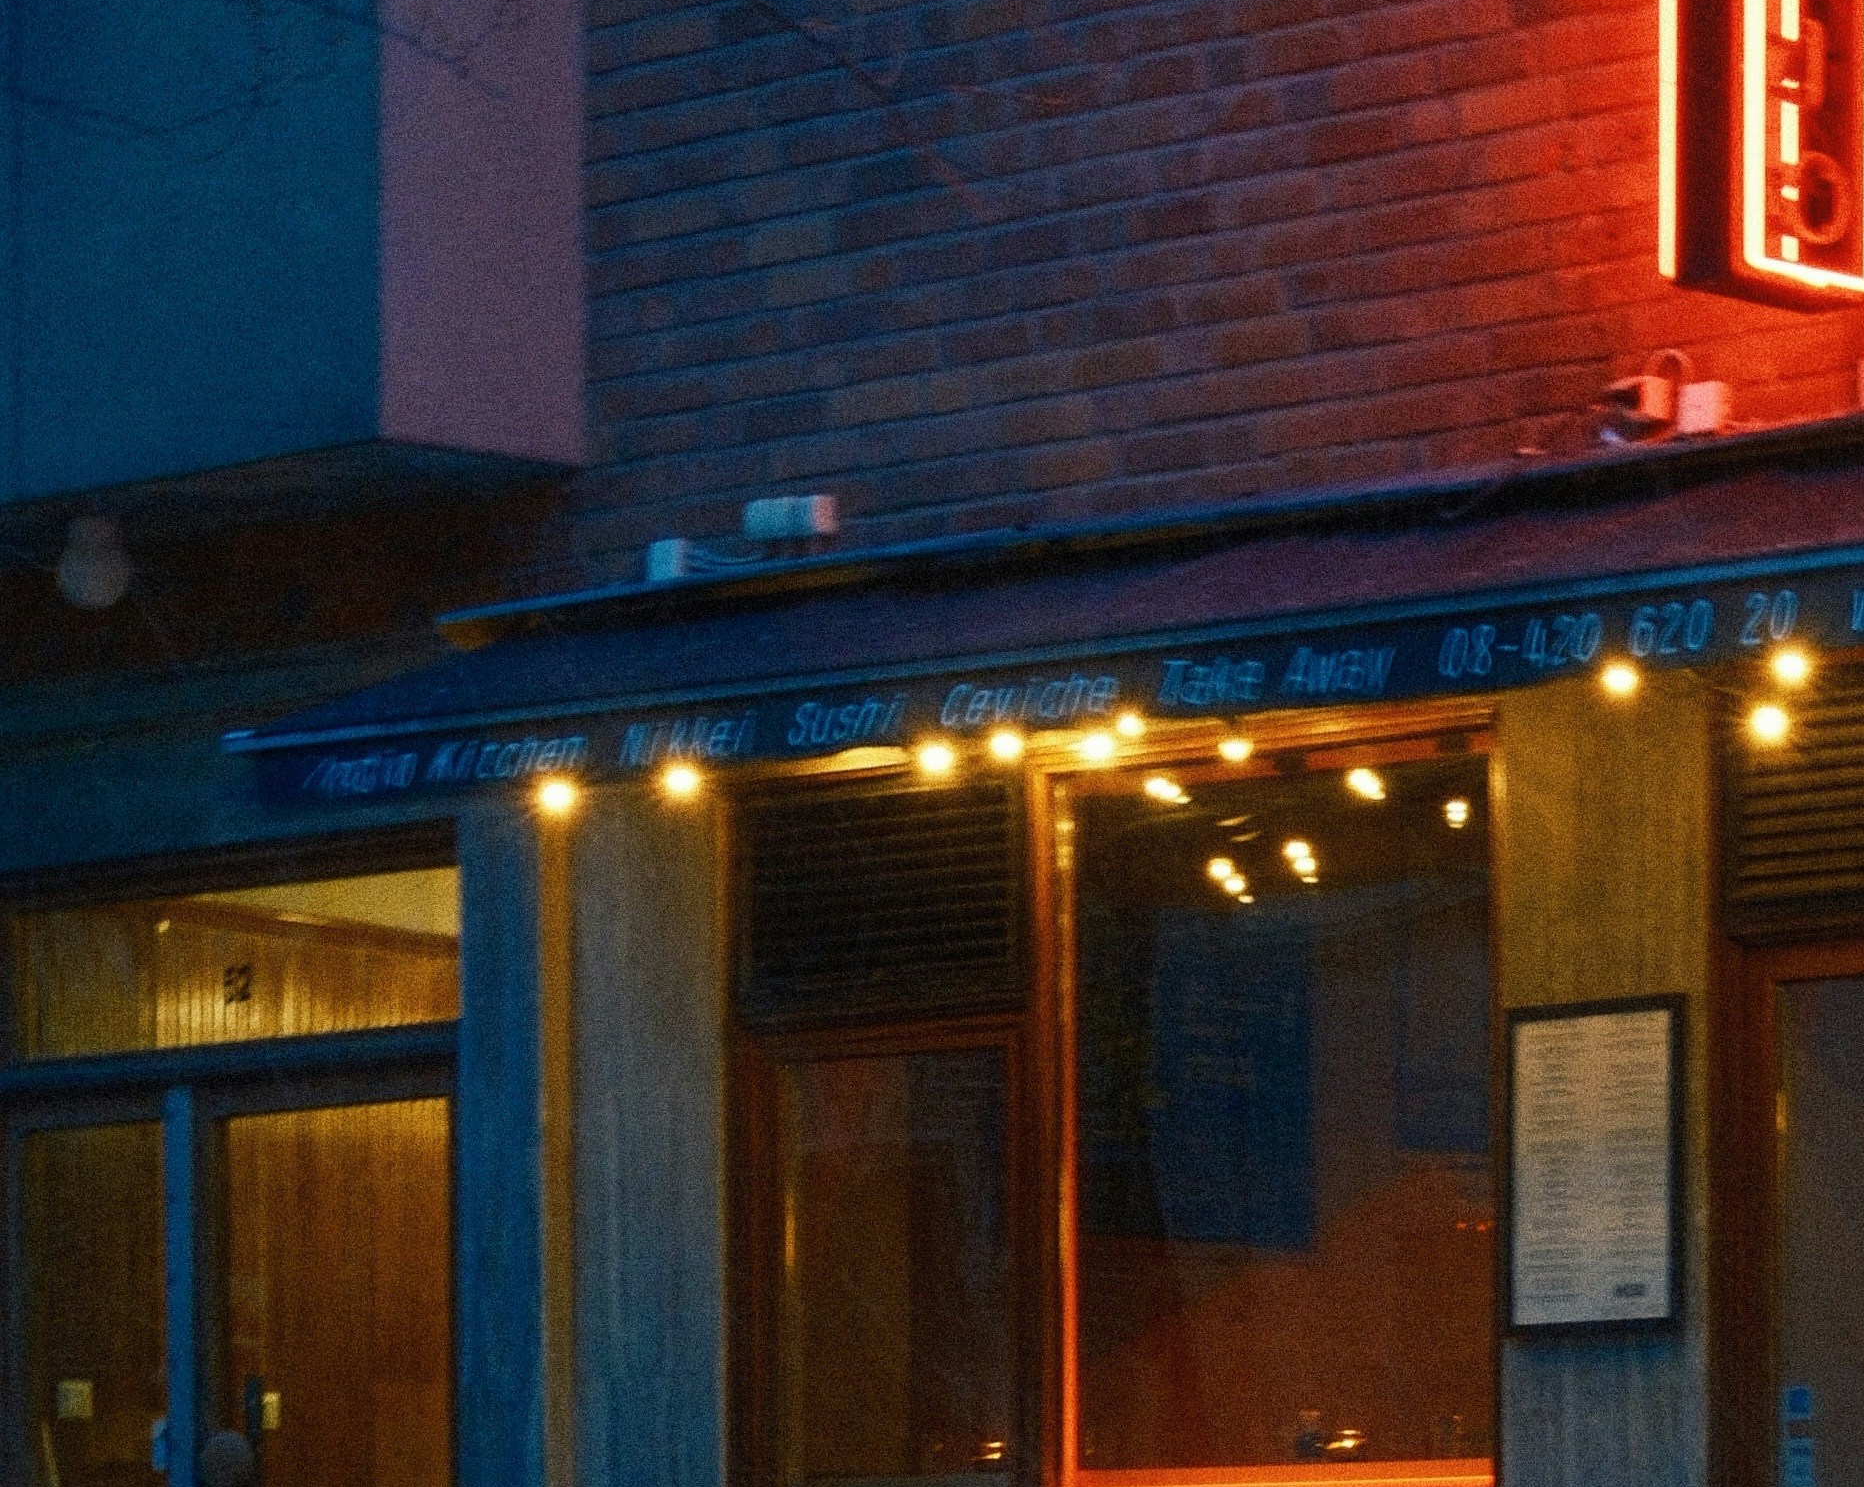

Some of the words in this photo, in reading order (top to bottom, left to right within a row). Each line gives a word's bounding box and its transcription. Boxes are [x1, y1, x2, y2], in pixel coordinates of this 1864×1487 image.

[429, 735, 588, 781] Kitchen
[622, 713, 757, 766] Nikkei
[788, 693, 906, 743] Sushi
[940, 672, 1118, 728] Ceviche
[1160, 657, 1265, 707] Take
[1281, 646, 1397, 696] Away
[1438, 611, 1603, 679] 08-420
[1628, 598, 1714, 658] 620
[1740, 589, 1798, 647] 20
